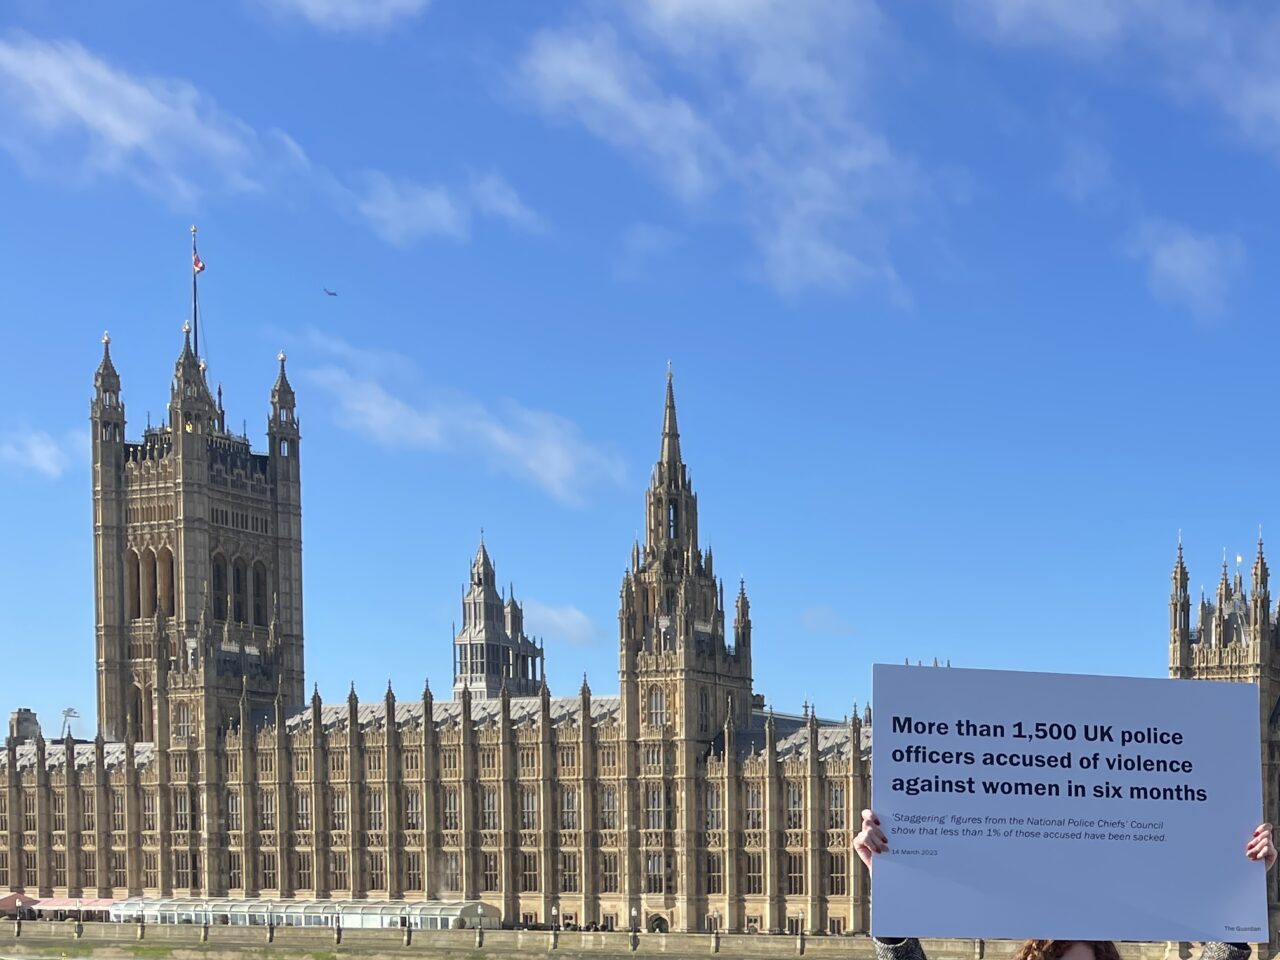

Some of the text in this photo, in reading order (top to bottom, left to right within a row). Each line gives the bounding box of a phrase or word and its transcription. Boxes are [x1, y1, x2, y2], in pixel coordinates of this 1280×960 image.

[892, 716, 1183, 746] More than 1,500 UK police
[892, 746, 1192, 773] officers accused of violence
[892, 776, 1207, 802] against women in six months
[891, 826, 916, 835] show
[918, 827, 938, 836] that
[940, 827, 959, 836] less
[962, 828, 983, 836] than
[986, 828, 1001, 837] 1%
[1003, 829, 1014, 838] of
[1015, 829, 1041, 838] those
[1043, 831, 1082, 840] accused
[1084, 831, 1106, 840] have
[1108, 832, 1131, 840] been
[950, 815, 983, 825] figures
[984, 816, 1006, 824] from
[1009, 817, 1024, 825] the
[1026, 817, 1066, 826] National
[1068, 818, 1095, 828] Police
[1130, 820, 1164, 830] Council
